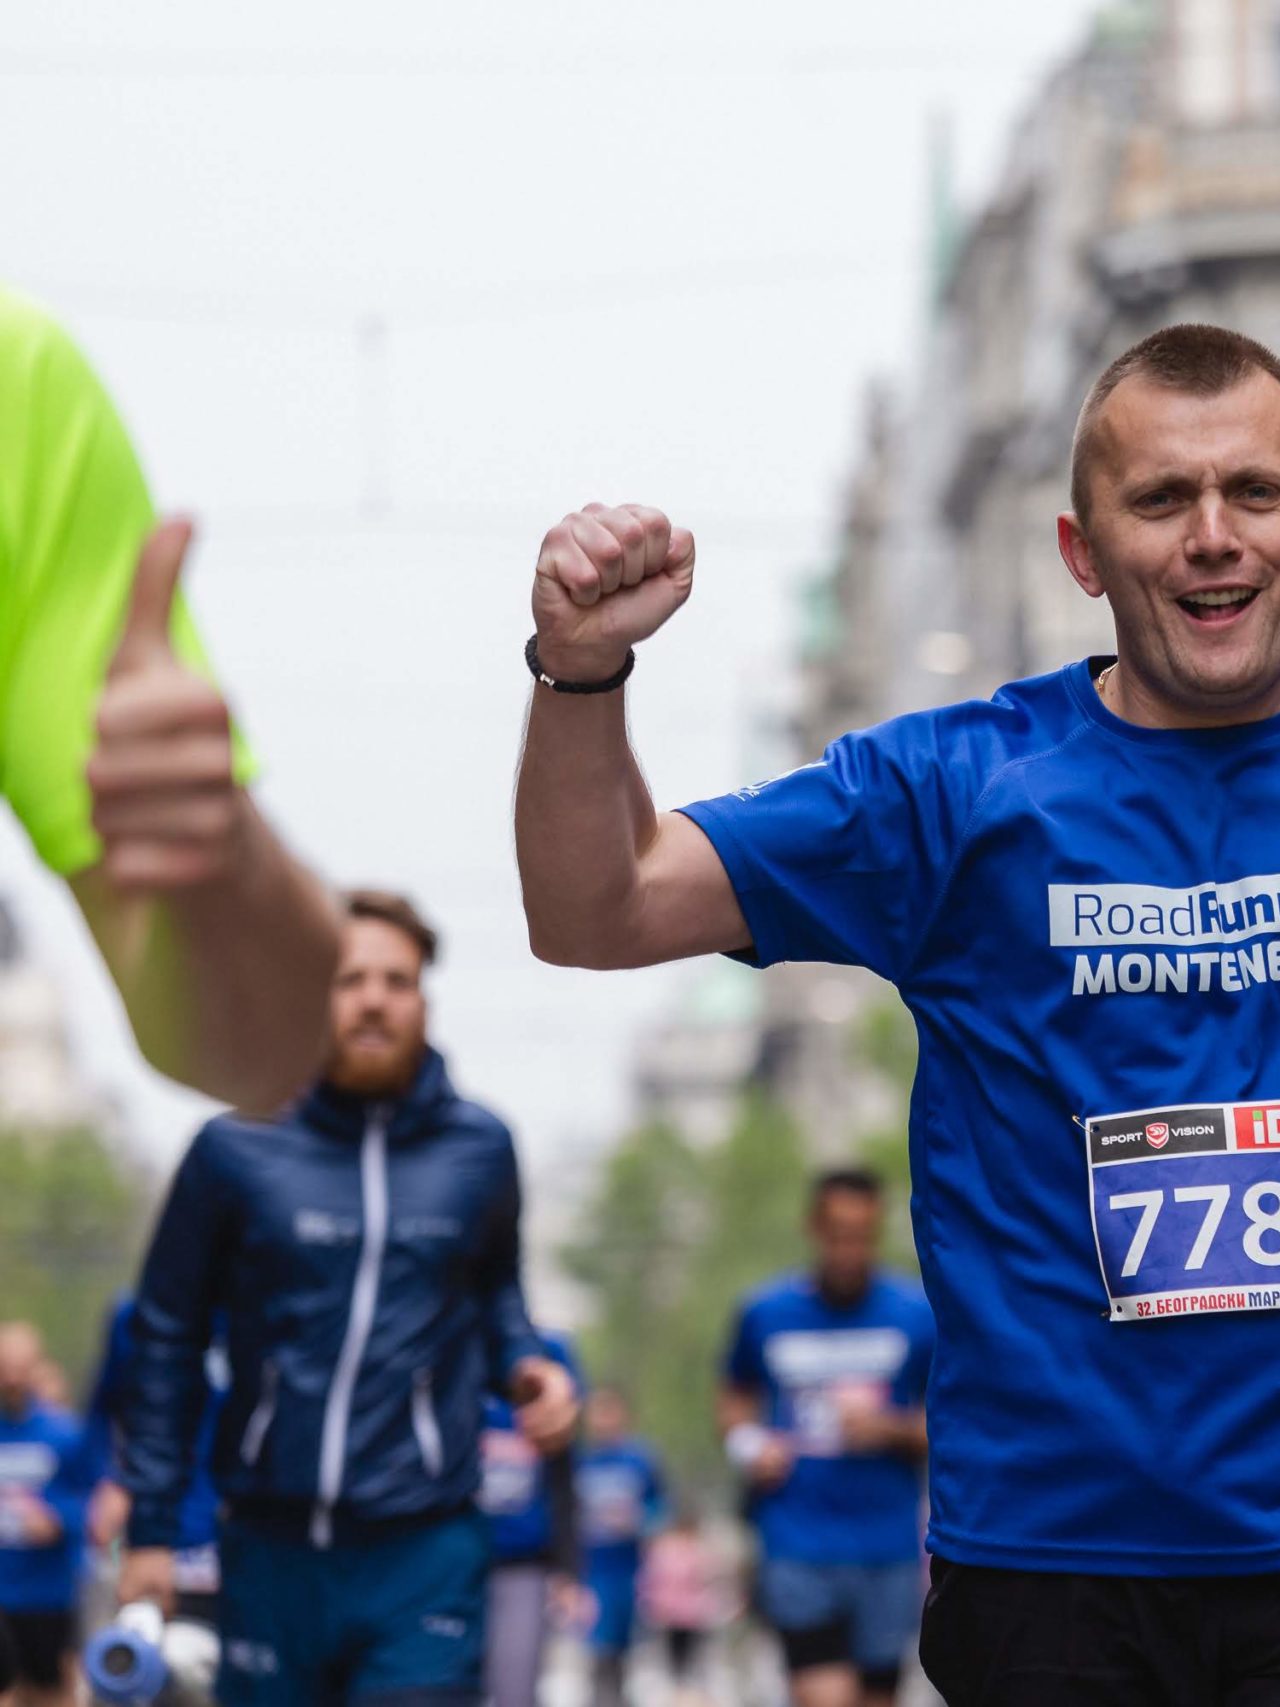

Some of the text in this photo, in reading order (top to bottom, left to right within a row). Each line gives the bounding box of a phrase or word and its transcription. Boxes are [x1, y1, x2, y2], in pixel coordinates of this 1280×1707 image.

[1101, 1125, 1214, 1146] SPORT VISION
[1156, 1293, 1245, 1315] БЕОГРАДСКИ
